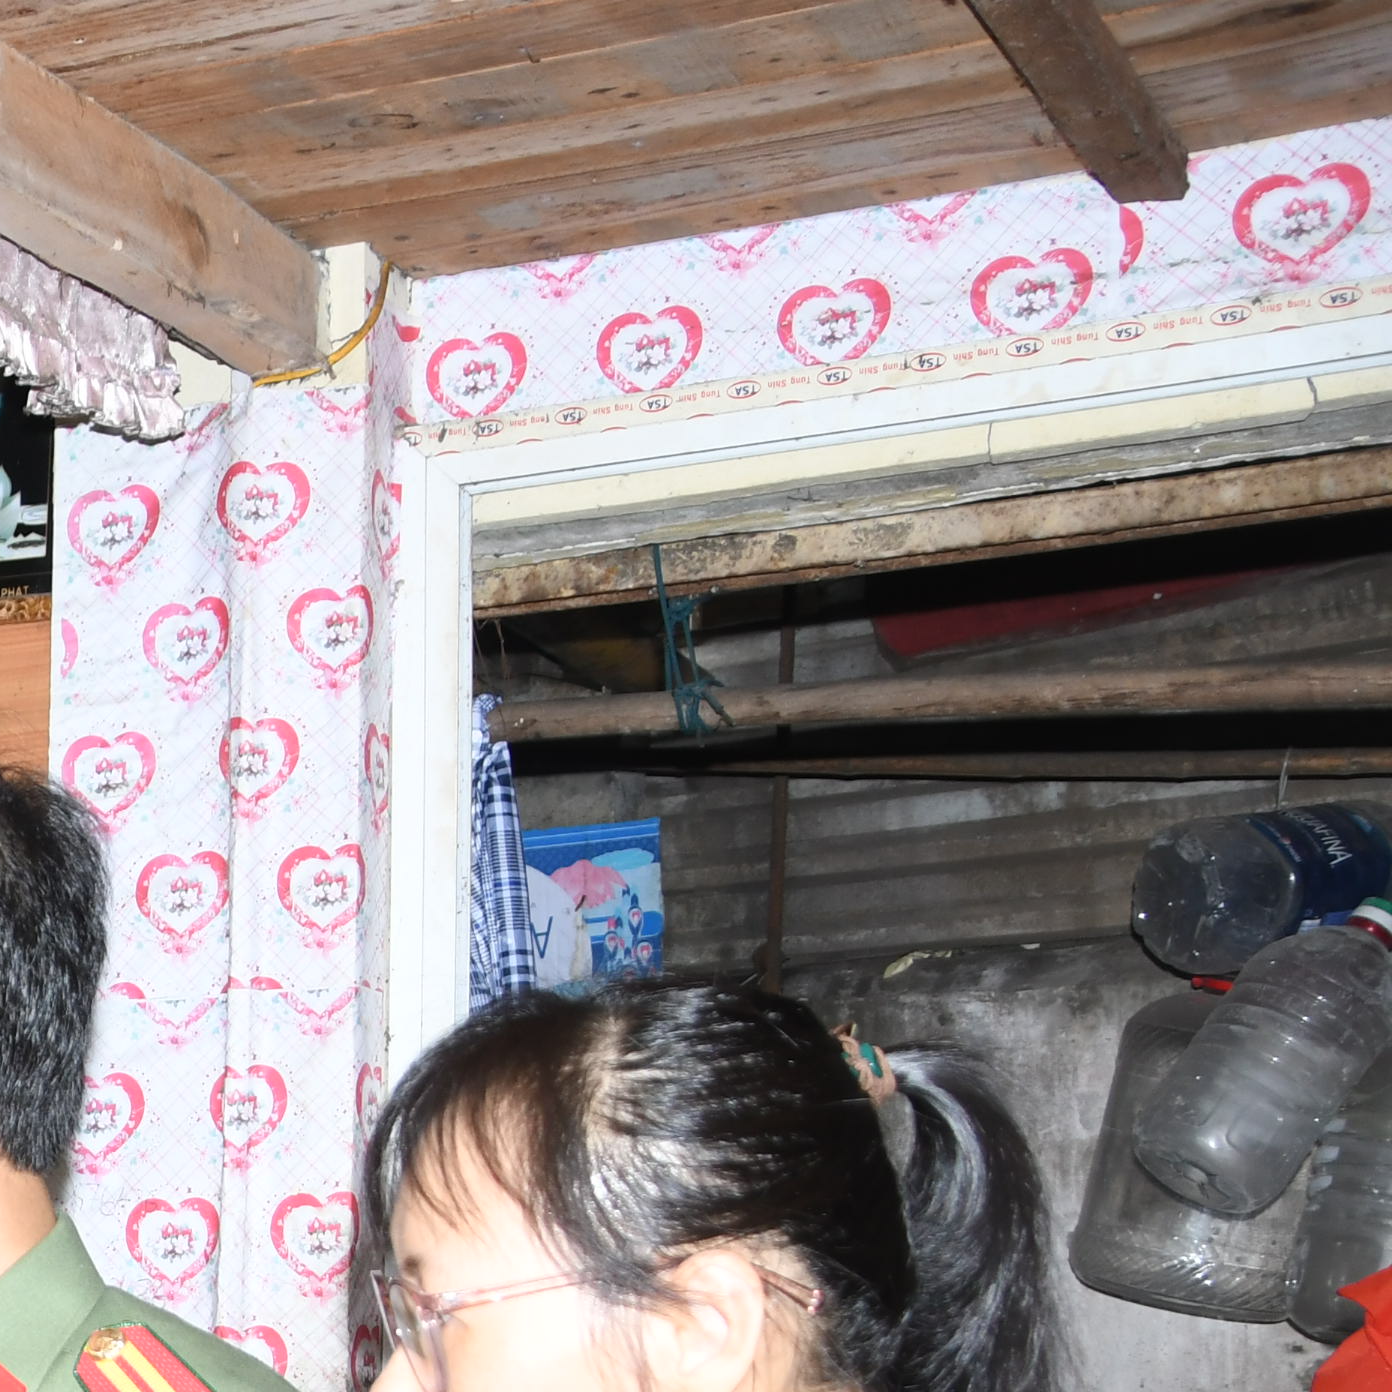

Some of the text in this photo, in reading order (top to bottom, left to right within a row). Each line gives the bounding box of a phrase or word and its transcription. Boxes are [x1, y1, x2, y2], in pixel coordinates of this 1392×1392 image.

[1330, 291, 1357, 306] TSA
[1220, 309, 1247, 323] TSA
[1116, 325, 1141, 339] TSA
[1014, 342, 1040, 355] TSA
[825, 370, 848, 382] TSA
[735, 384, 757, 396] TSA
[647, 396, 668, 409] TSA
[562, 410, 582, 423] TSA
[1279, 809, 1353, 866] UAFINA
